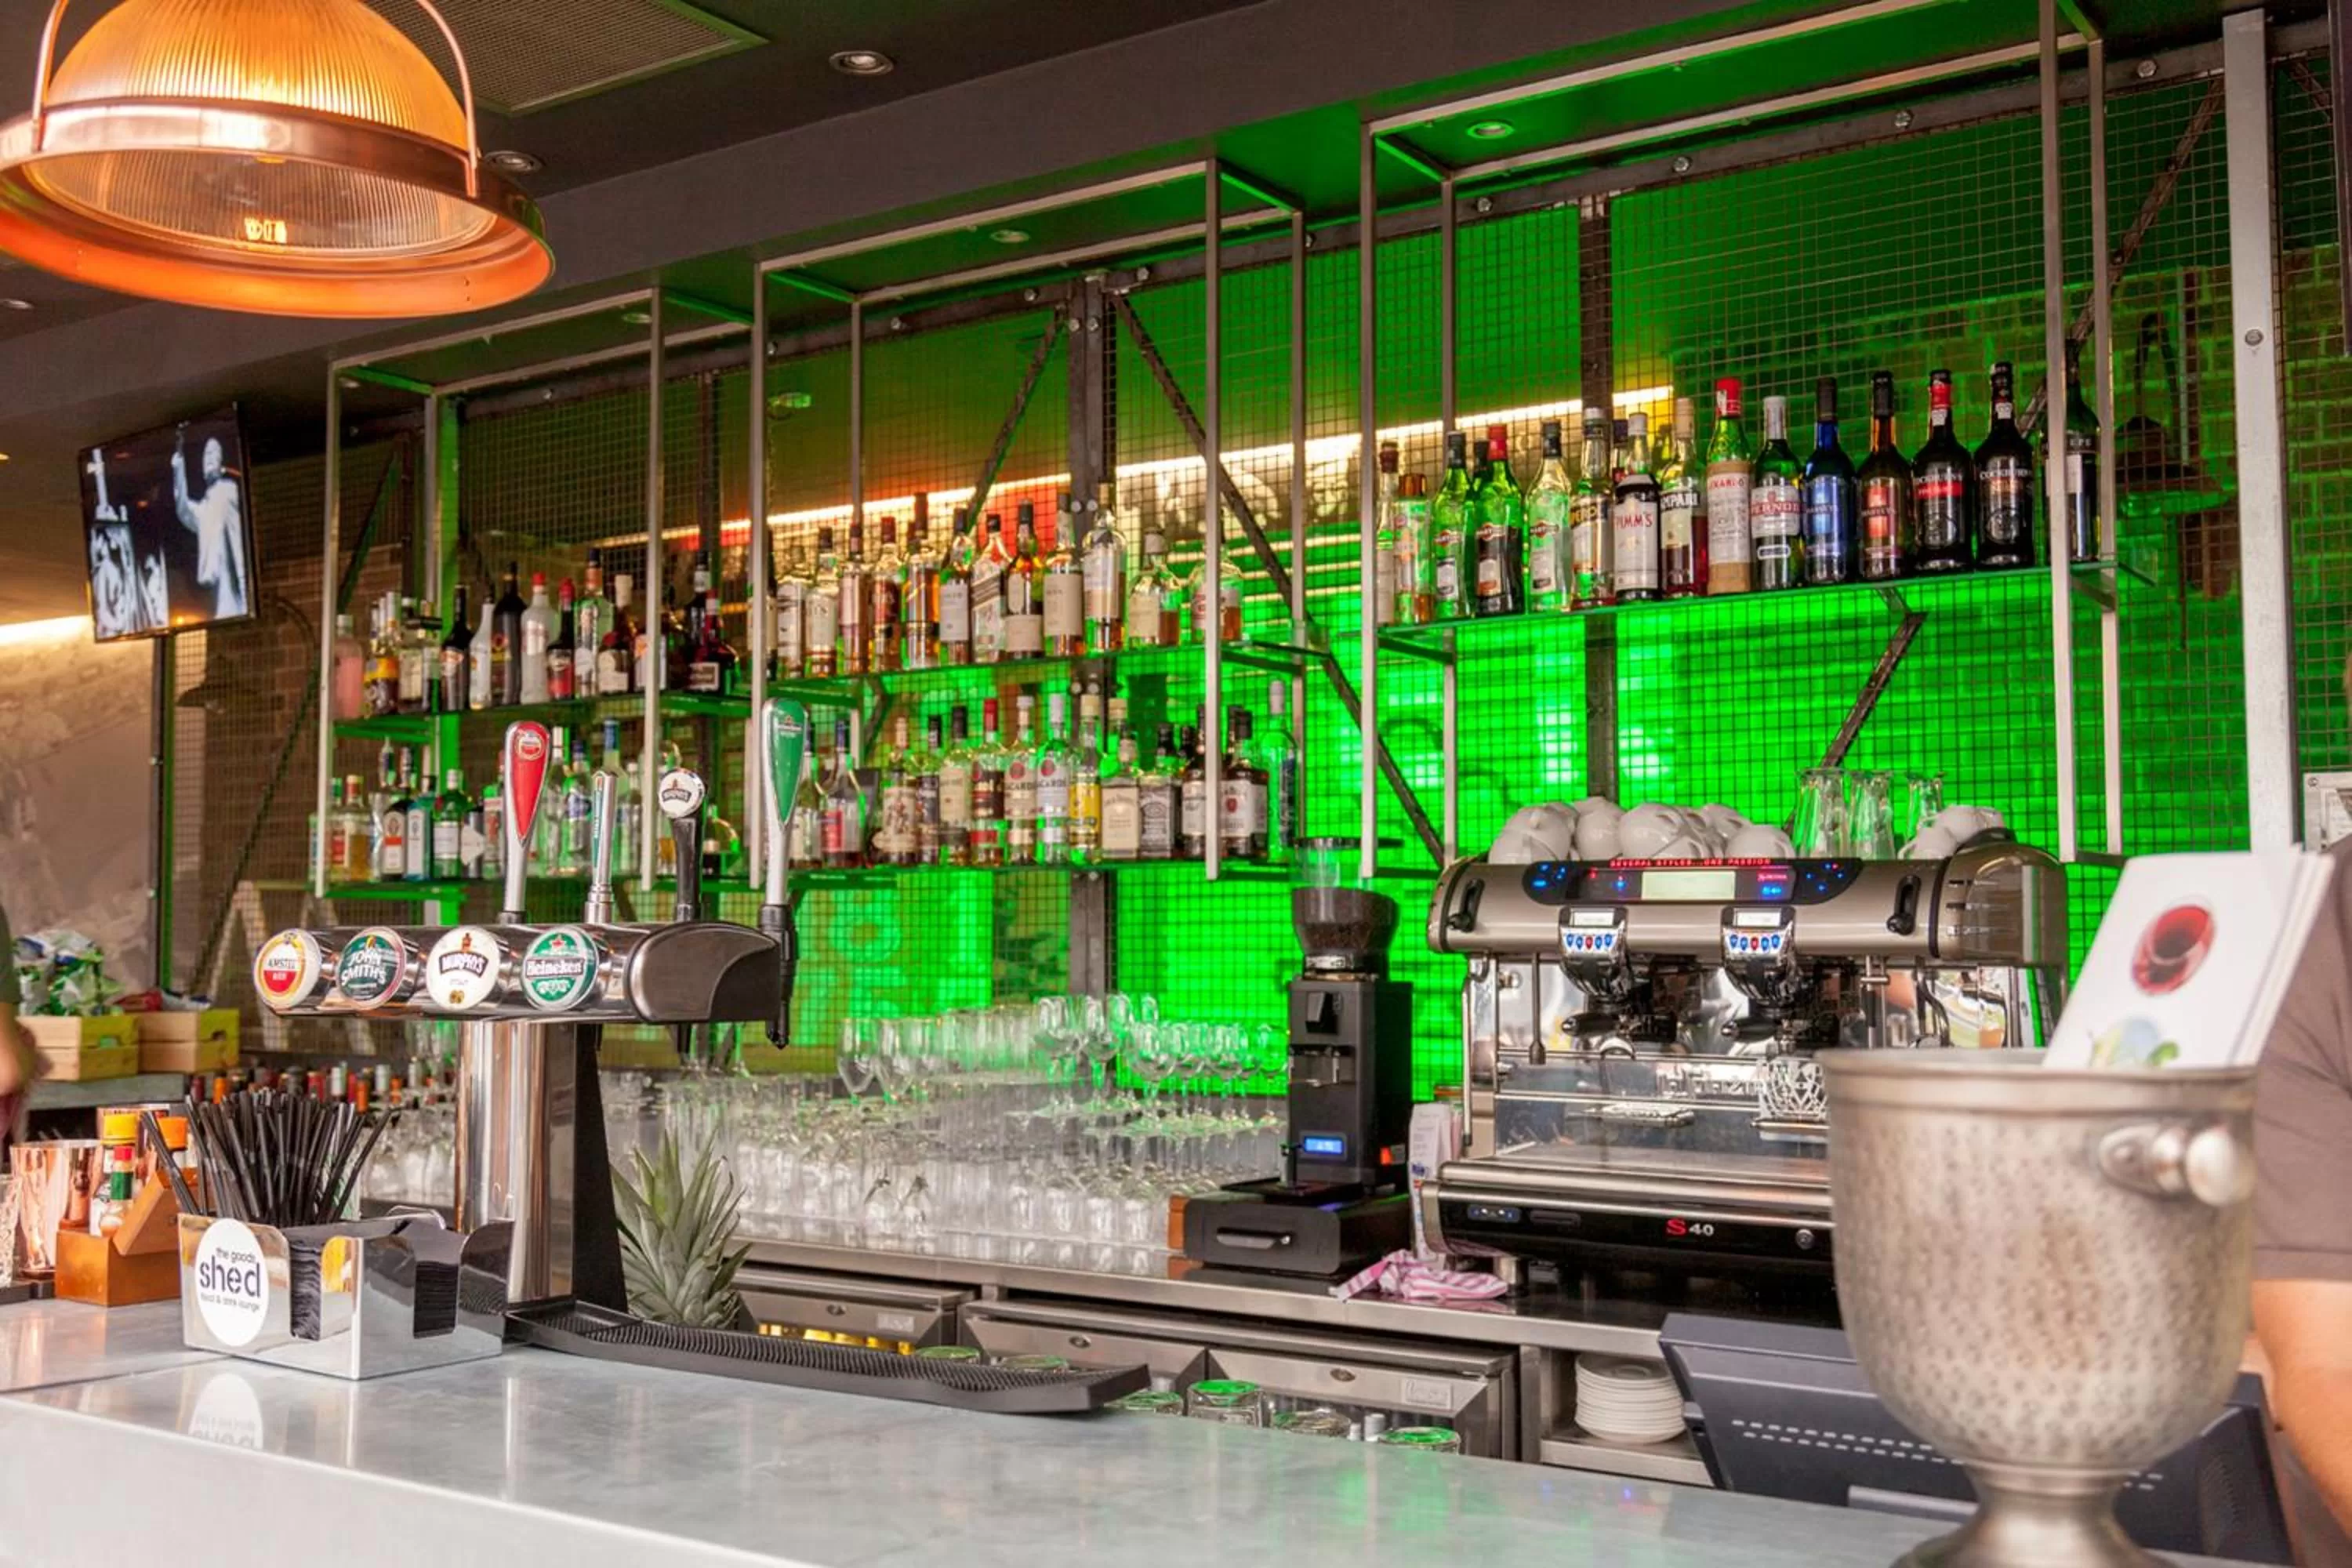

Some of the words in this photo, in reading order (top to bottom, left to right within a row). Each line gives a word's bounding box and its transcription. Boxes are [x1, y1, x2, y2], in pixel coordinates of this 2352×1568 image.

[347, 949, 382, 966] JOHN
[341, 965, 386, 986] SMITH'S
[526, 960, 583, 976] Heineken
[216, 1247, 229, 1259] the
[231, 1250, 256, 1264] goods
[200, 1254, 260, 1298] shed
